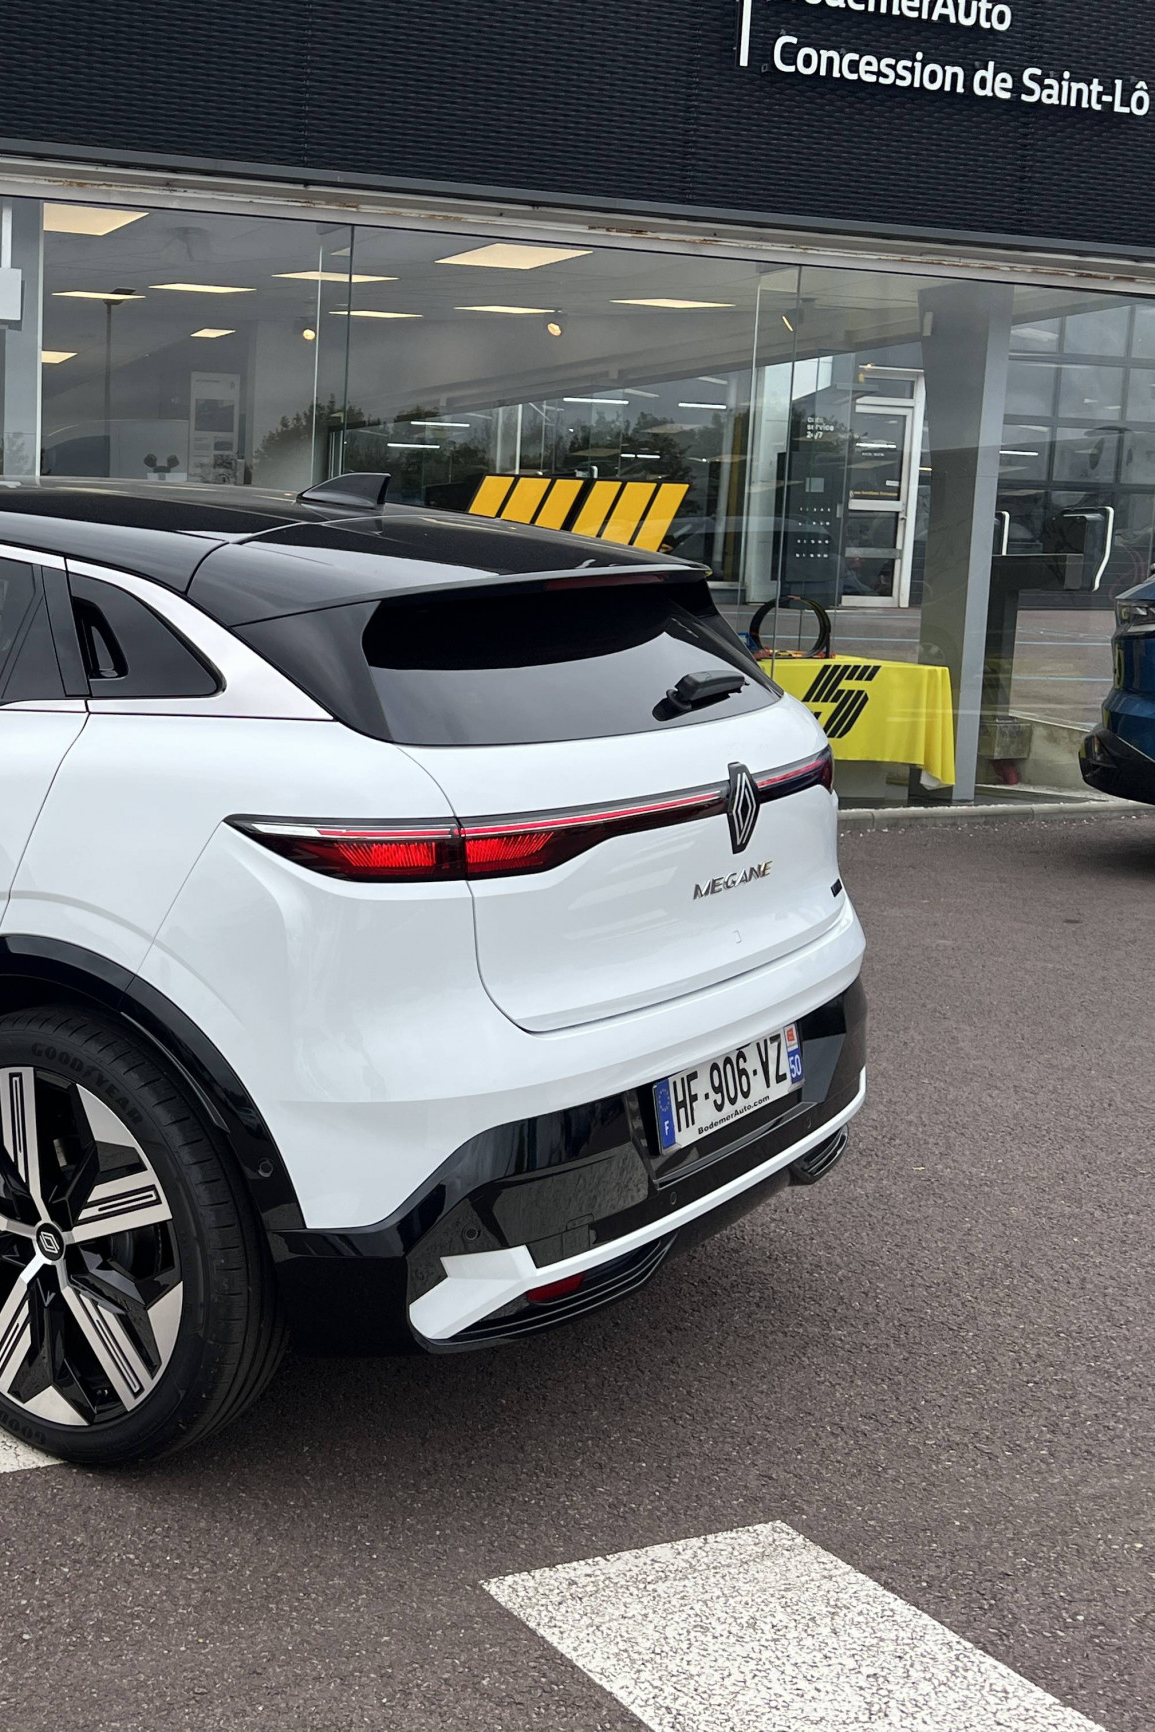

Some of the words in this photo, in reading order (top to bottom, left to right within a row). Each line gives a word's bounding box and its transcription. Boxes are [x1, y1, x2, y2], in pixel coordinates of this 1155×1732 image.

[773, 35, 965, 93] Concession
[973, 60, 1013, 99] de
[1021, 67, 1150, 116] Saint-Lô
[692, 860, 773, 900] MEGANE
[31, 1042, 144, 1125] GOODYEAR
[664, 1120, 670, 1136] F
[788, 1054, 802, 1078] 50
[697, 1094, 770, 1135] BodemerAuto.com
